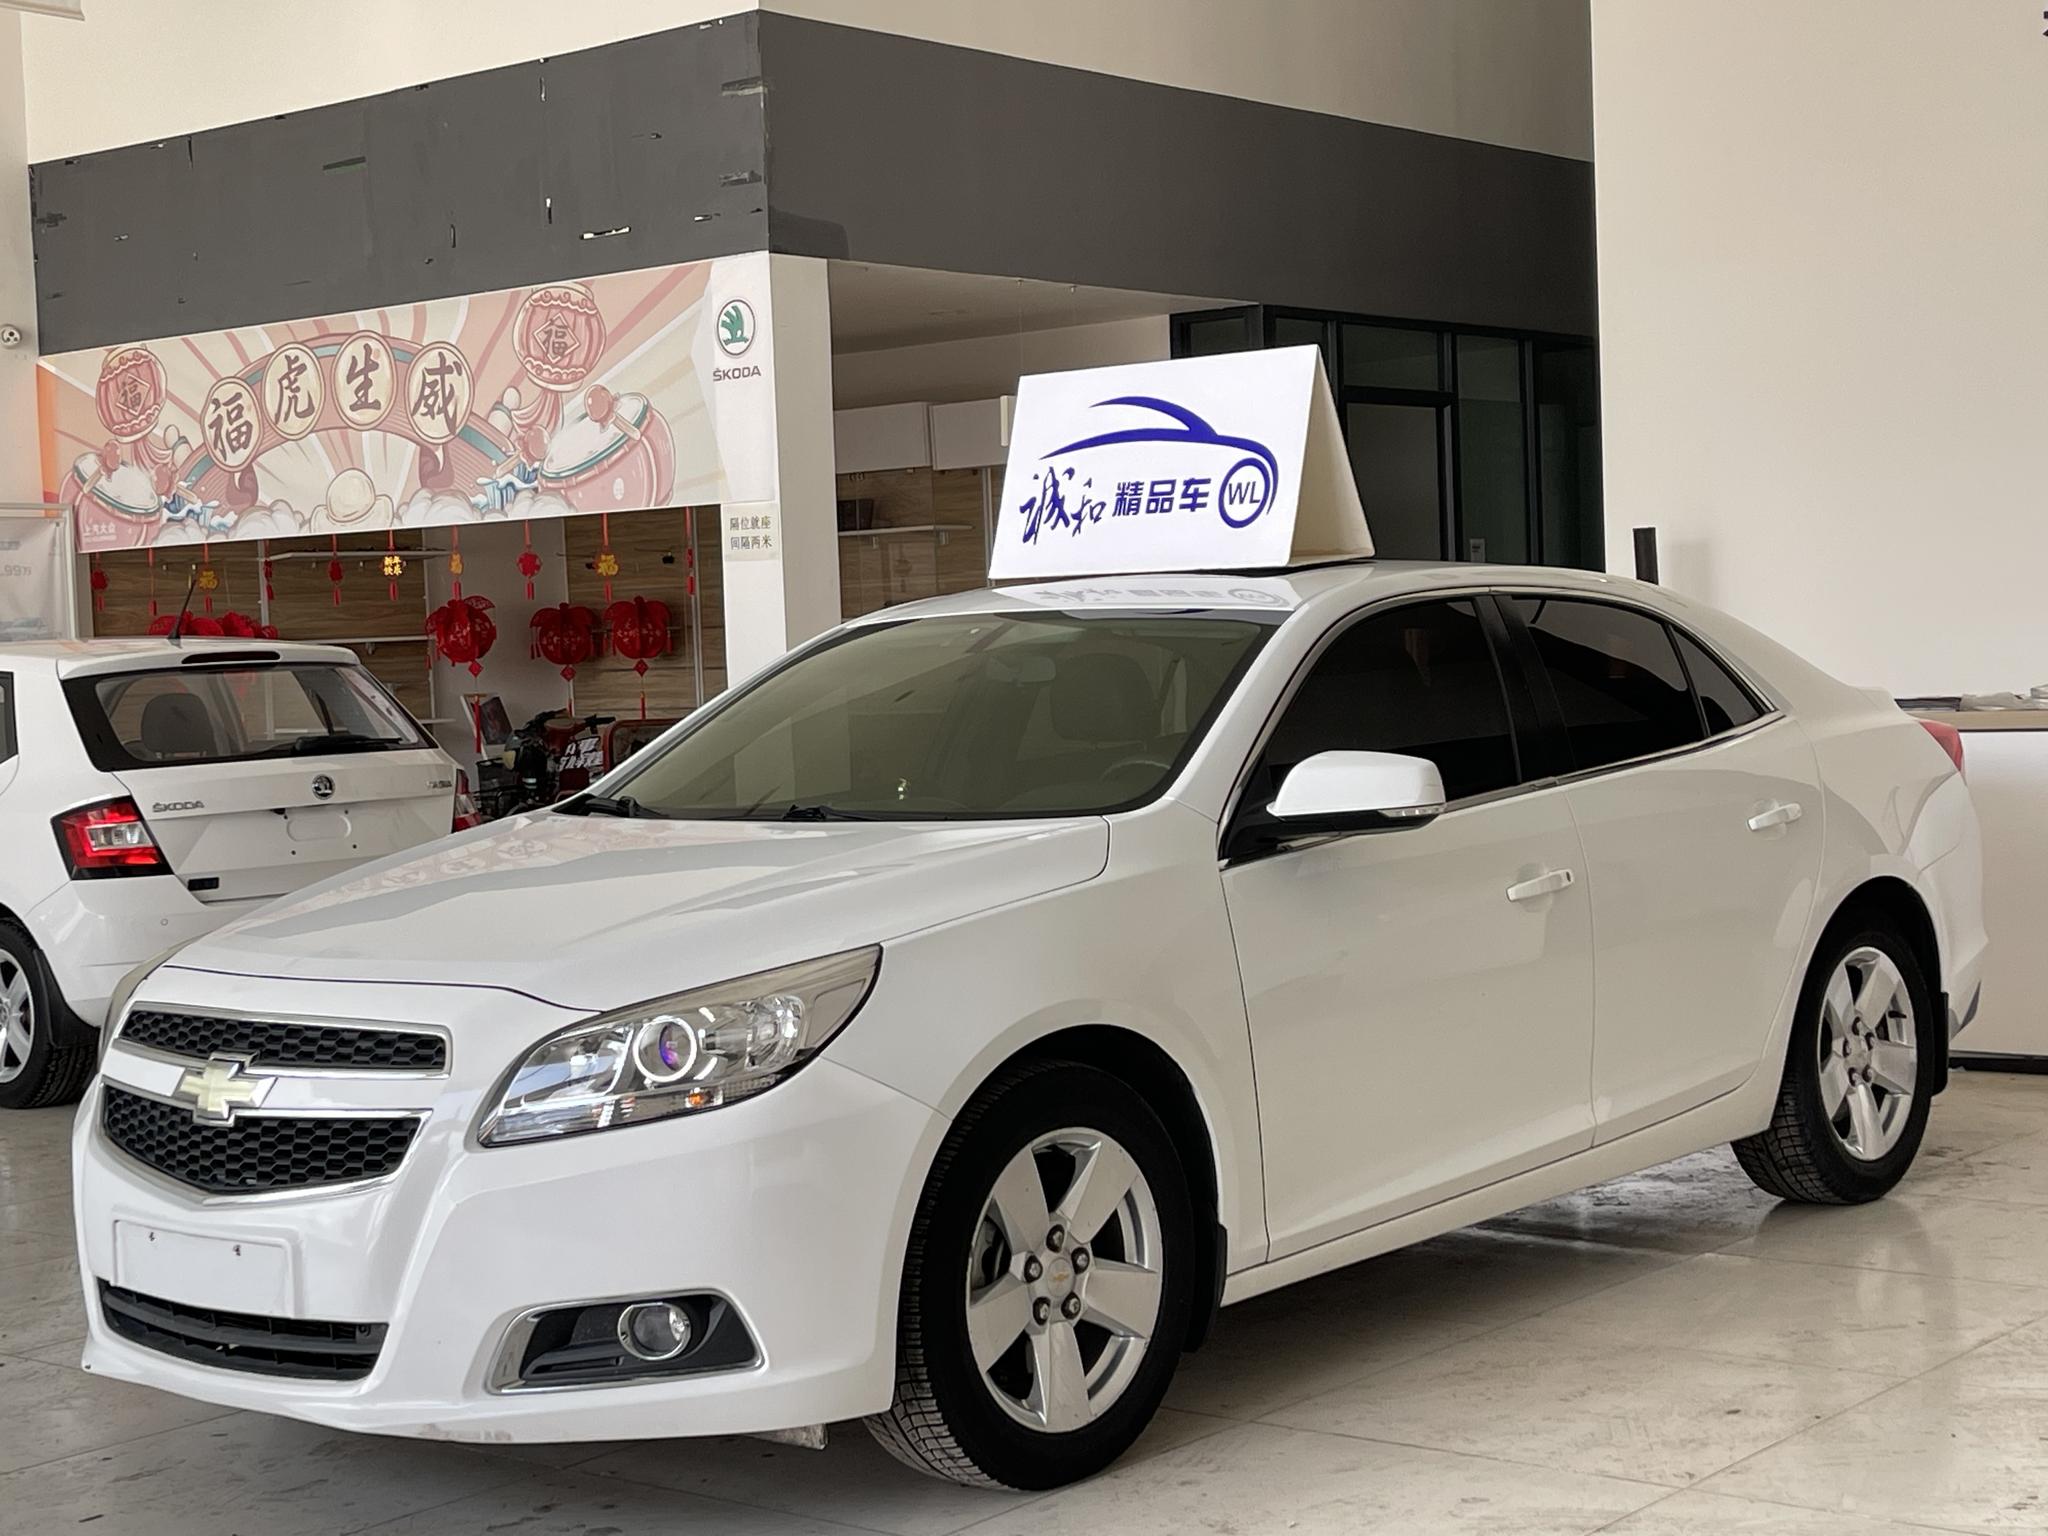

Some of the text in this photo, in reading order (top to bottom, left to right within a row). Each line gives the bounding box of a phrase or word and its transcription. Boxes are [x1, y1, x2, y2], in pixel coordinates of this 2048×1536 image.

[542, 319, 568, 357] 福
[713, 366, 761, 381] ŠKODA
[119, 379, 142, 409] 福
[208, 344, 463, 460] 福虎生威
[1227, 482, 1261, 506] WL
